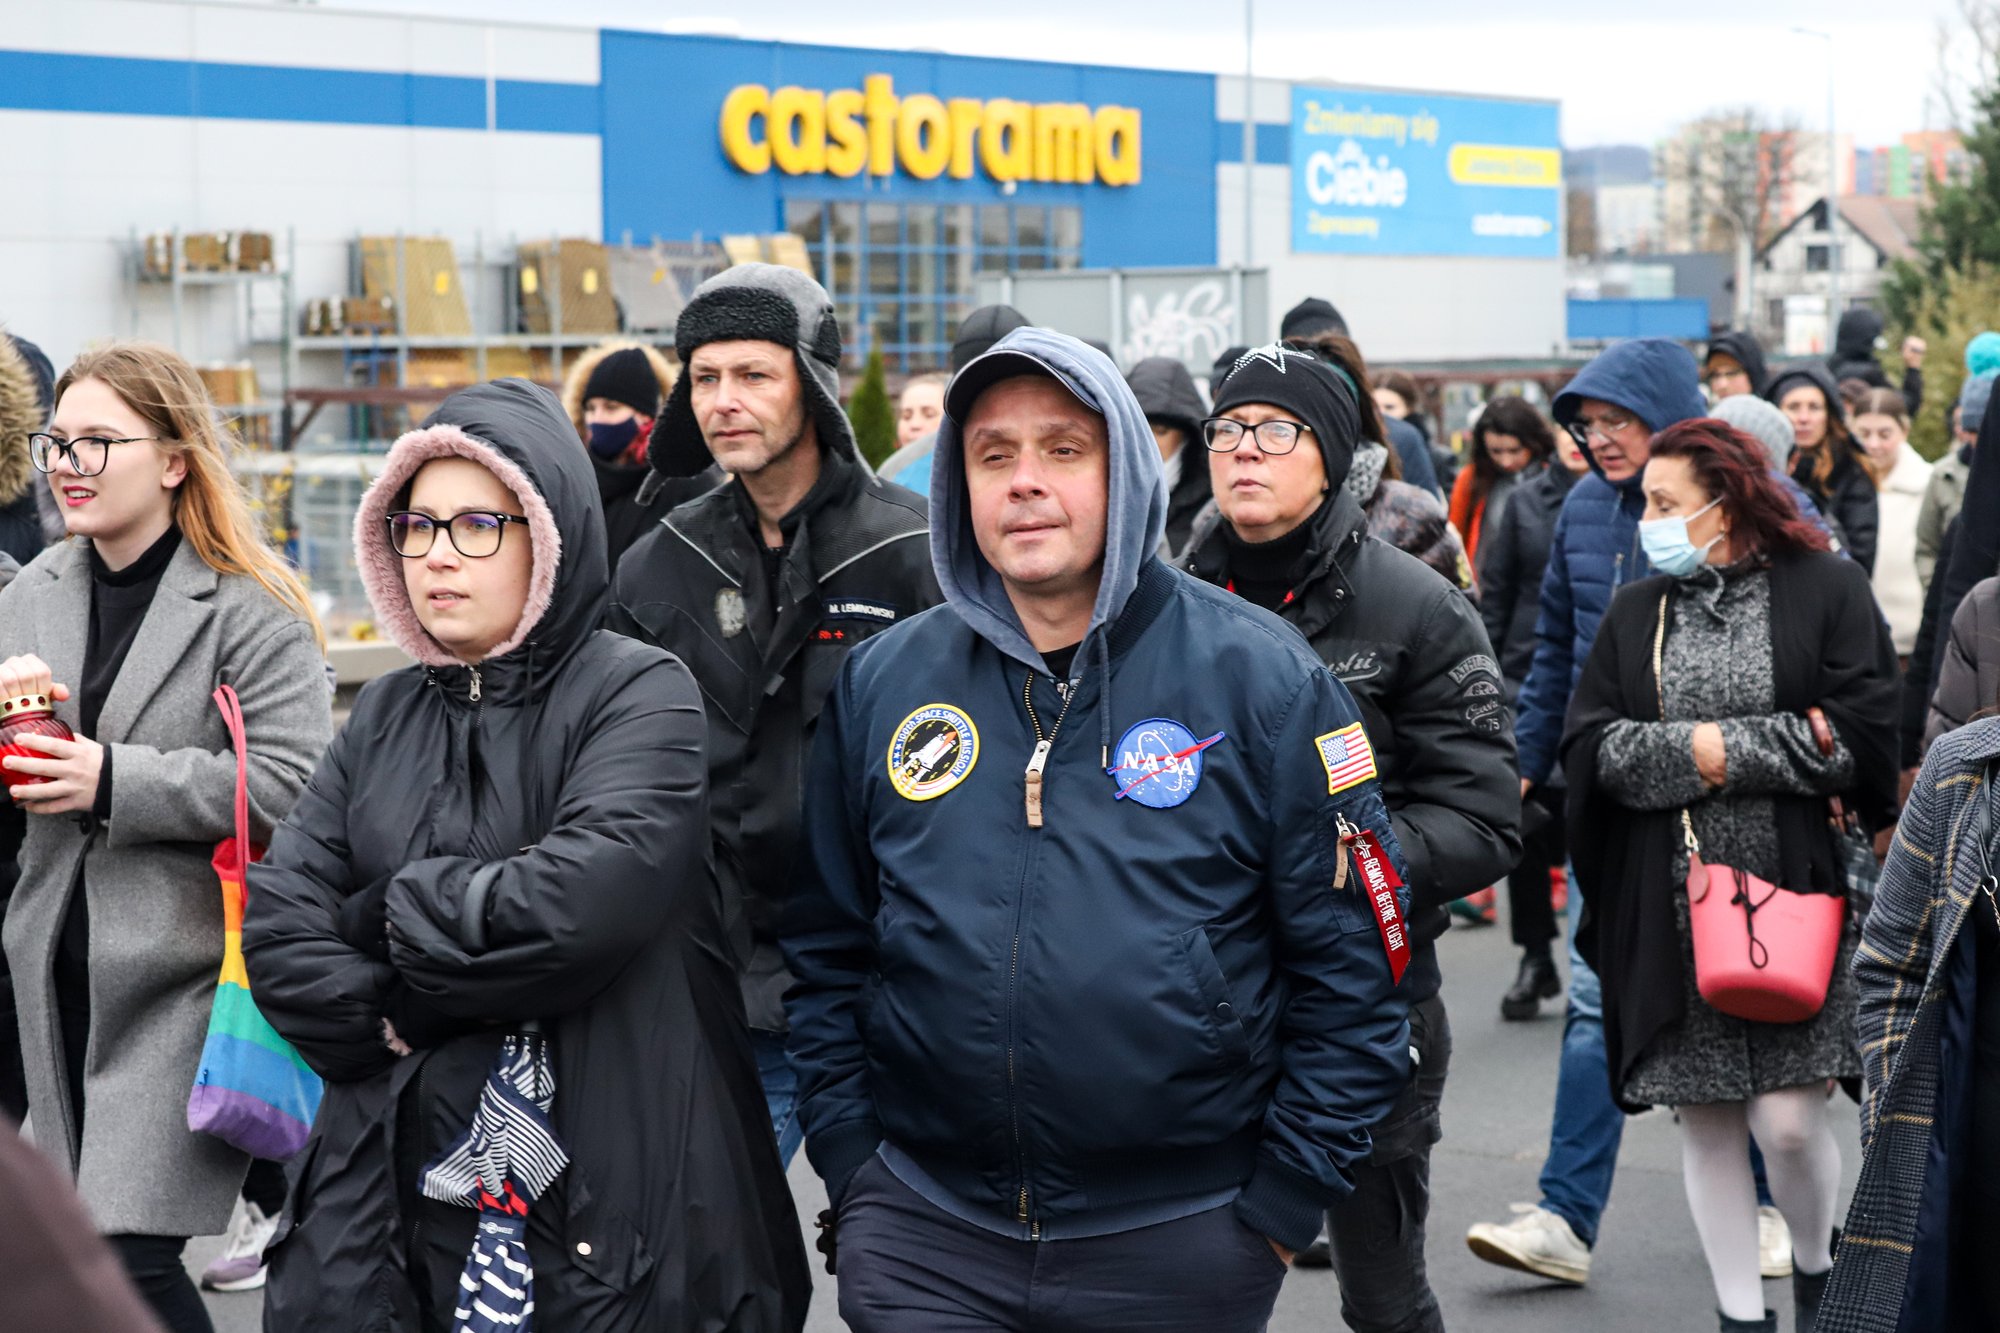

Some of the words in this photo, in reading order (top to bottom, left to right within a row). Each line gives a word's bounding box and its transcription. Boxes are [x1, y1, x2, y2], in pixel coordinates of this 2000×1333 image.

[720, 73, 1141, 187] castorama
[915, 709, 943, 724] SPACE
[942, 710, 971, 739] SHUTTLE
[897, 720, 917, 743] 100th
[952, 739, 973, 775] MISSION
[1122, 750, 1196, 776] NASA
[1362, 857, 1389, 894] REMOVE
[1375, 890, 1398, 924] BEFORE
[1385, 923, 1405, 951] FLIGHT
